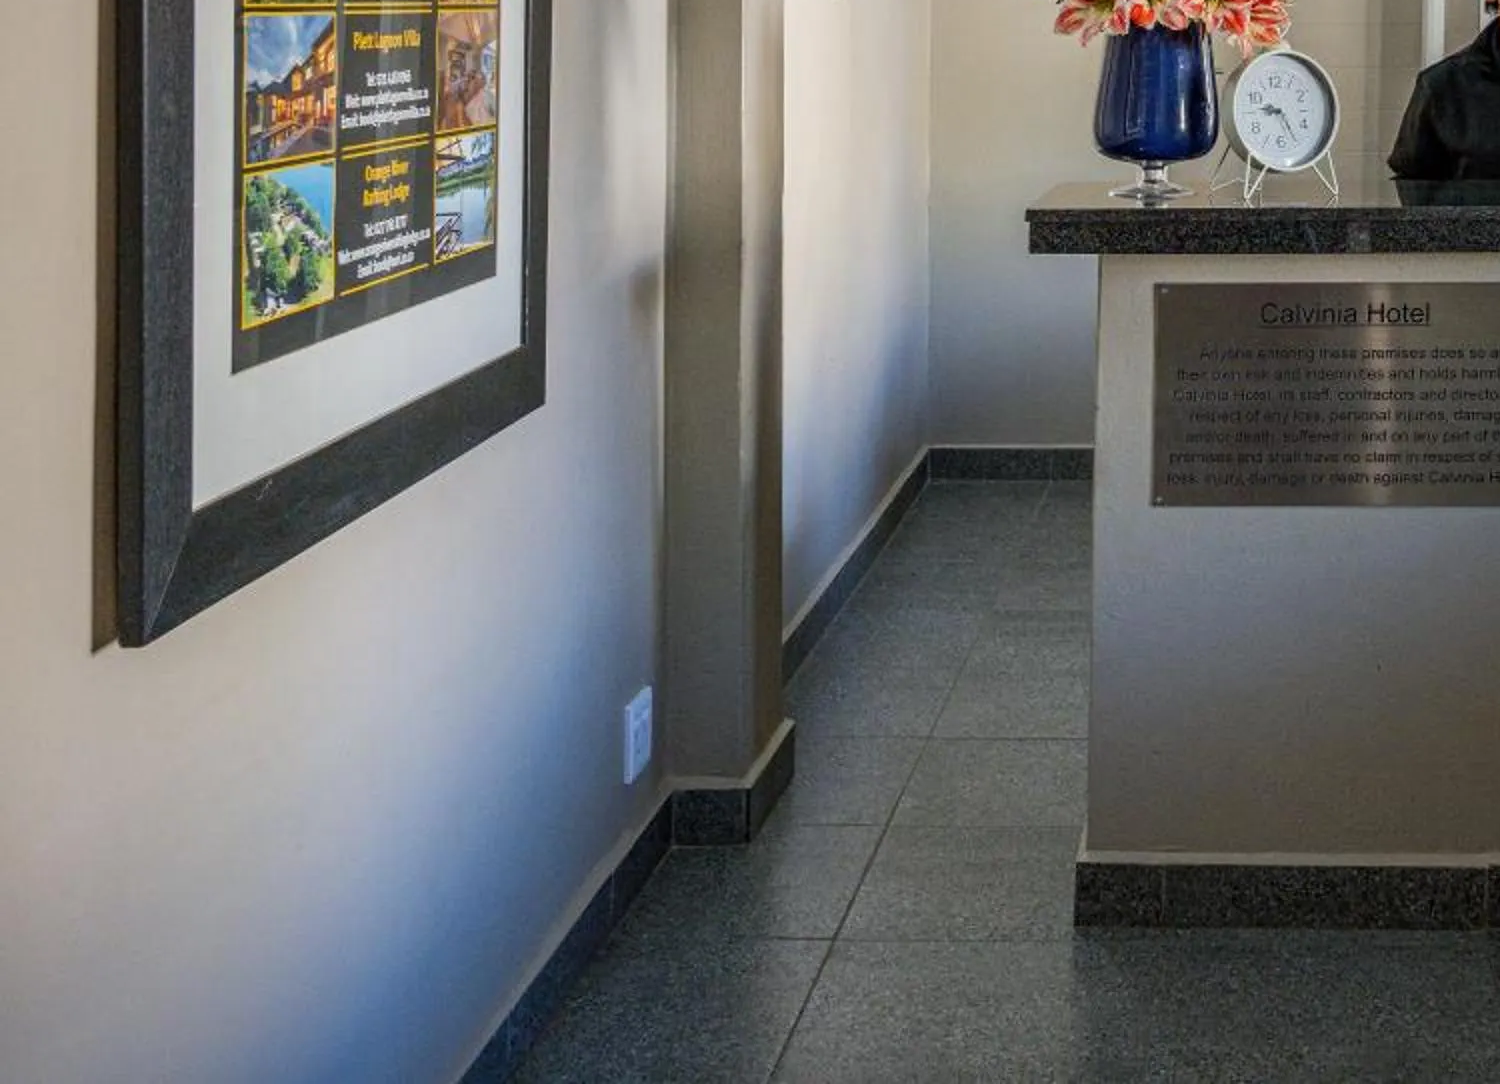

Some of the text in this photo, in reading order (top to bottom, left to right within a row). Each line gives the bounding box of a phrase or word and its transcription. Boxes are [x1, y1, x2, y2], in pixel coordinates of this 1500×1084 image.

[1260, 301, 1431, 324] Calvinia Hotel
[1361, 347, 1427, 363] premises
[1431, 346, 1464, 359] does
[1389, 368, 1415, 381] and
[1419, 367, 1457, 381] holds
[1337, 388, 1414, 401] contractors
[1419, 388, 1447, 401] and
[1474, 429, 1488, 442] of
[1343, 453, 1361, 464] no
[1365, 451, 1401, 464] claim
[1423, 452, 1476, 466] respect
[1479, 451, 1492, 463] of
[1373, 471, 1424, 487] against
